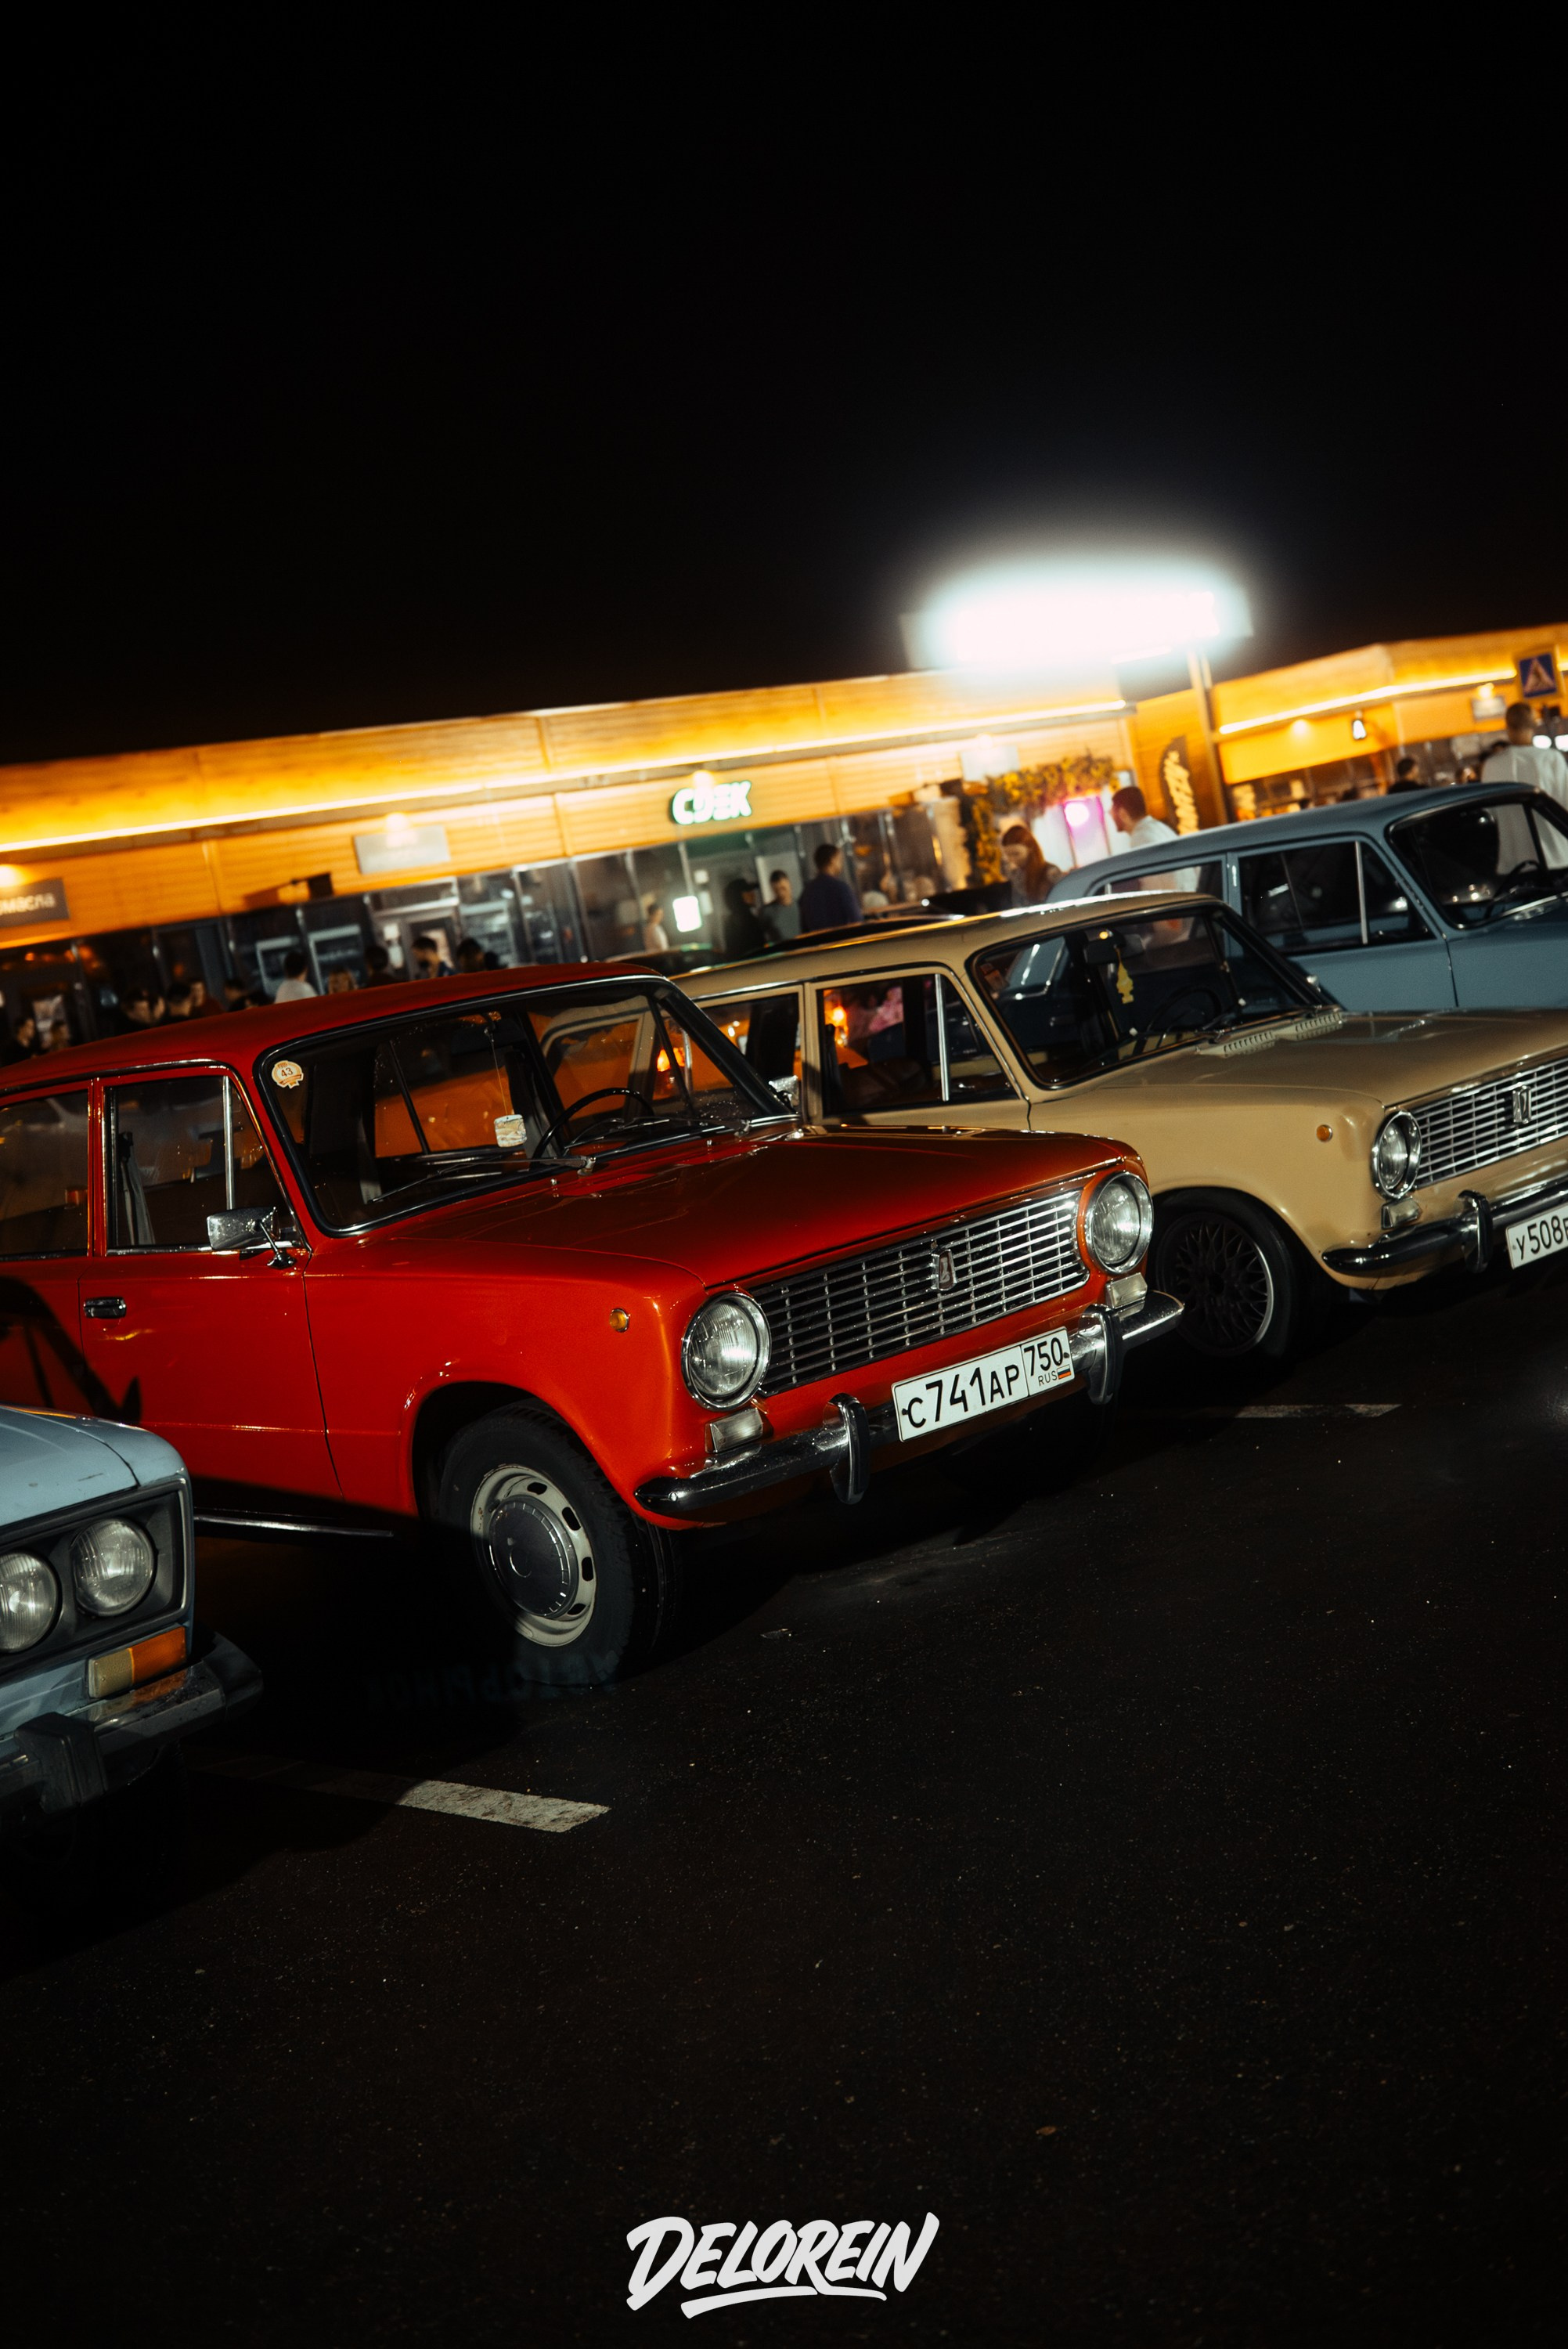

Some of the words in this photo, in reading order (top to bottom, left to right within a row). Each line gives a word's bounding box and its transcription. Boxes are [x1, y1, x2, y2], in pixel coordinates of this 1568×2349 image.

[281, 1067, 294, 1077] 43
[1024, 1337, 1063, 1376] 750
[1038, 1370, 1058, 1387] RUS
